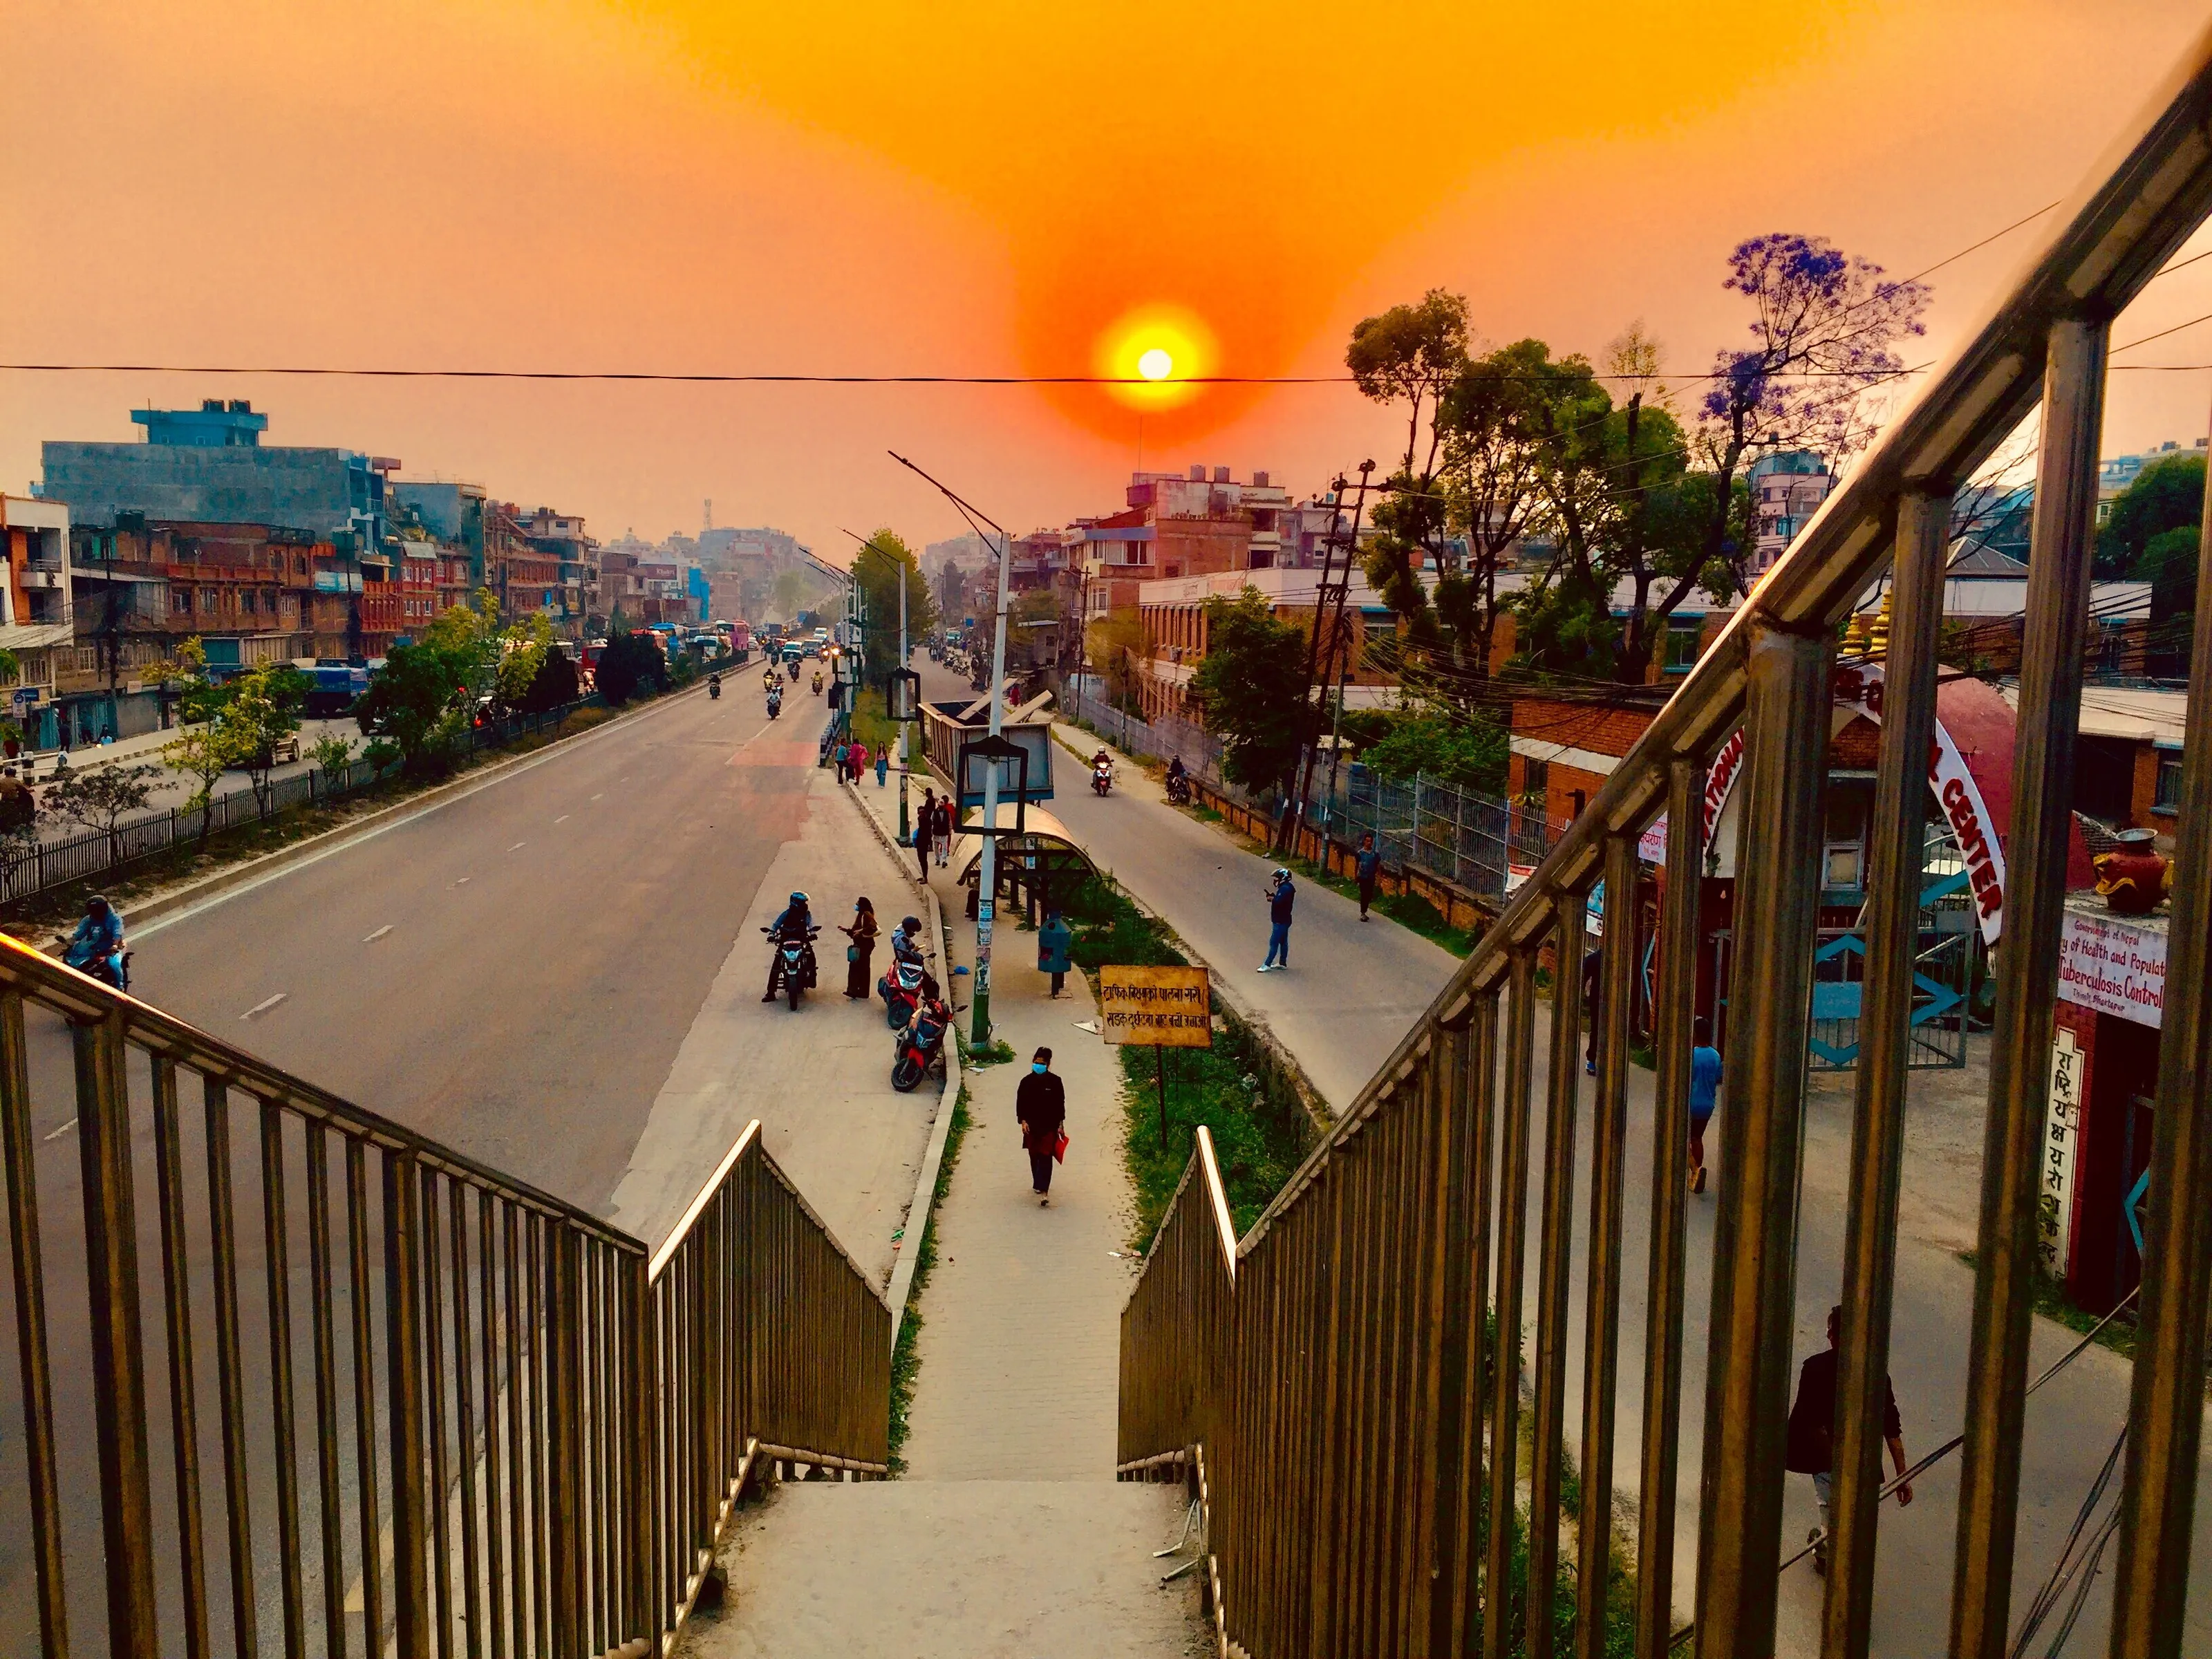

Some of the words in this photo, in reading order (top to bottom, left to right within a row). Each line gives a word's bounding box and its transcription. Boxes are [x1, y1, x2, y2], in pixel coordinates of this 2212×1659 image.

[1942, 778, 2003, 921] CENTER
[2058, 955, 2123, 997] Tuberculosis
[2124, 975, 2164, 1009] Control
[2081, 939, 2109, 961] Health
[2110, 951, 2127, 966] and
[2130, 953, 2166, 977] Populat
